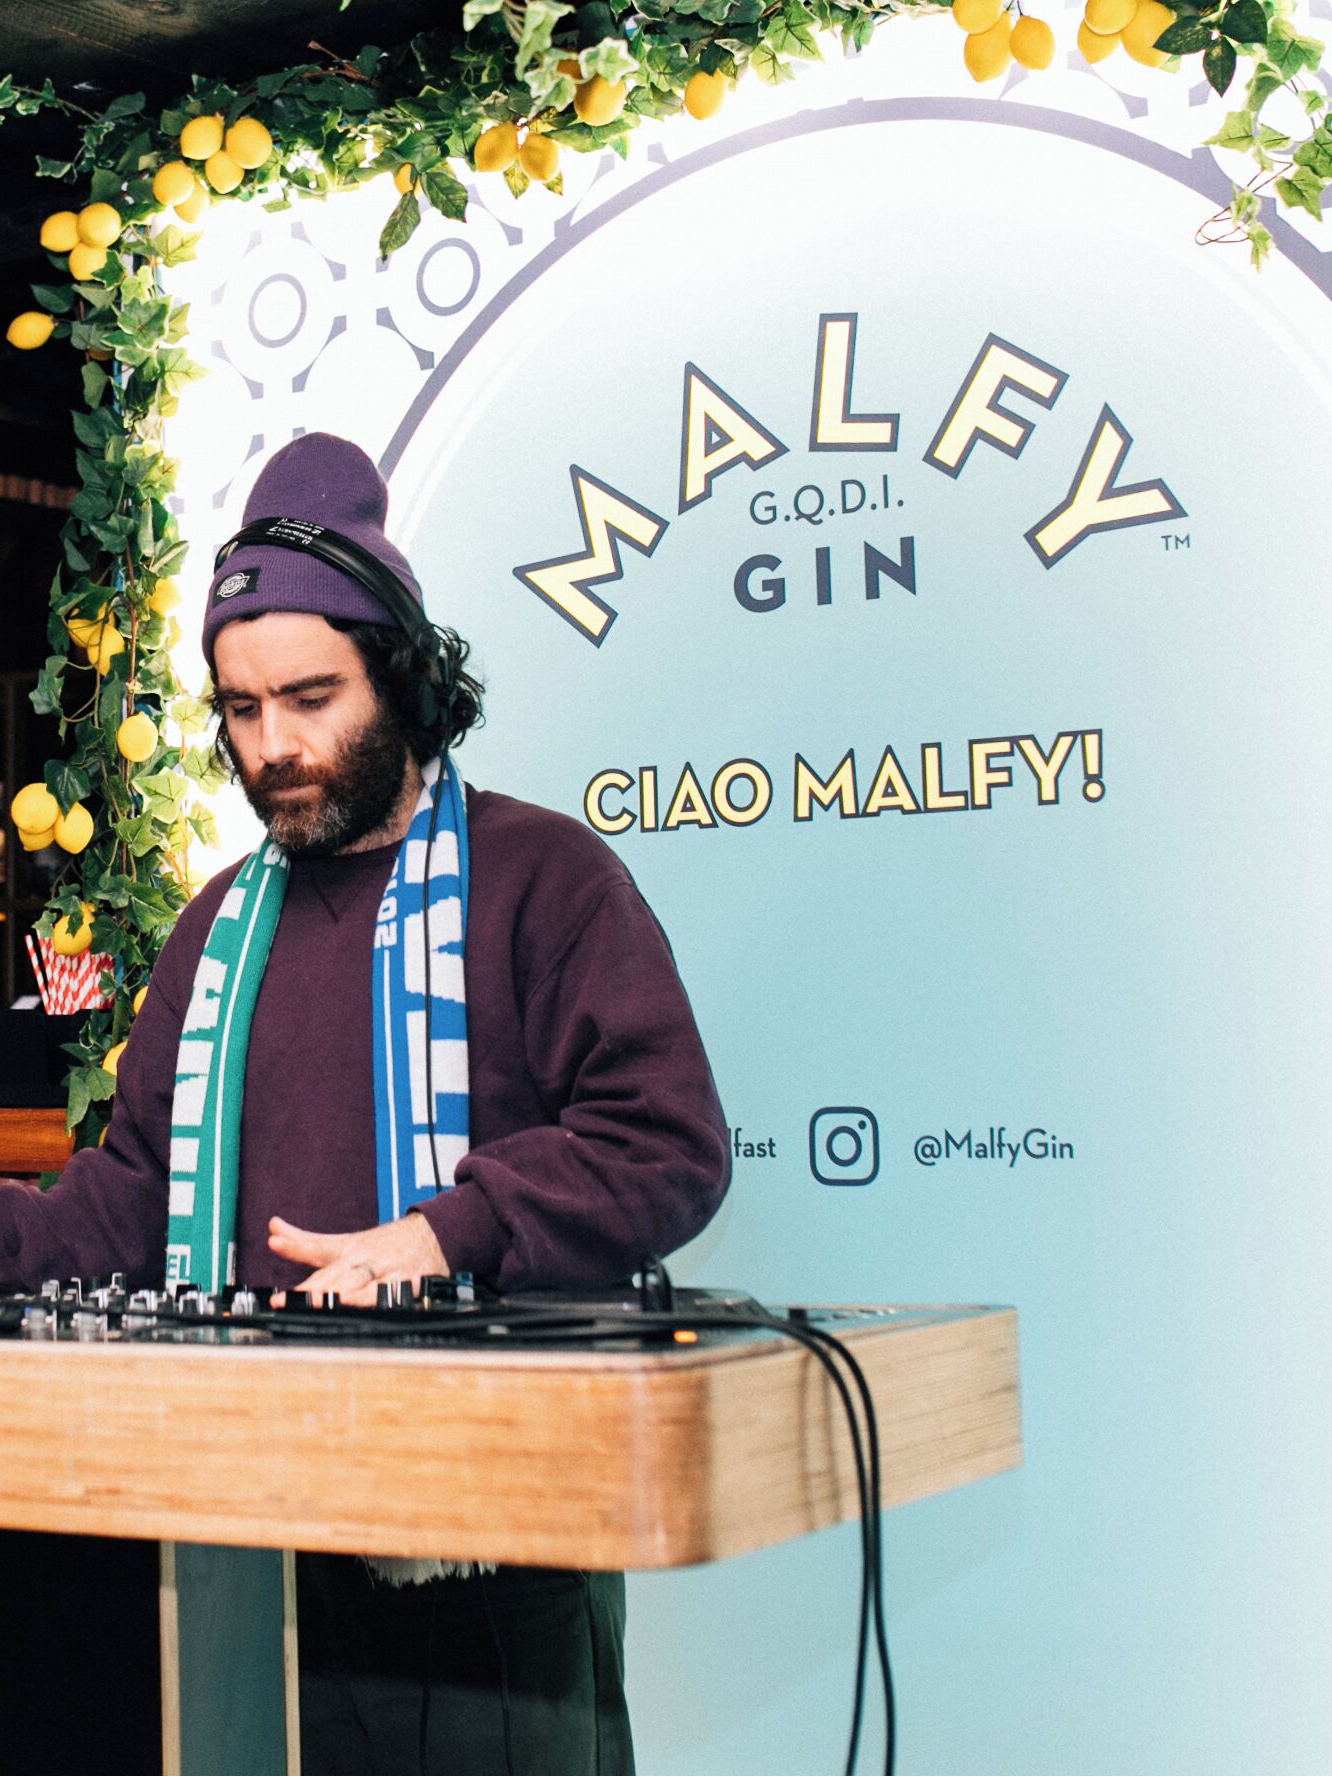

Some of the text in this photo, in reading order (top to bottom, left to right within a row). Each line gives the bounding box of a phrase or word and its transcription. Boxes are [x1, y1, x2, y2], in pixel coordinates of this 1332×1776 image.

[512, 312, 1189, 648] MALFY
[749, 474, 904, 526] G.Q.D.I.
[733, 535, 917, 613] GIN
[1160, 533, 1190, 551] TM
[584, 728, 1107, 836] CIAO MALFY!
[914, 1126, 1075, 1168] @MalfyGin
